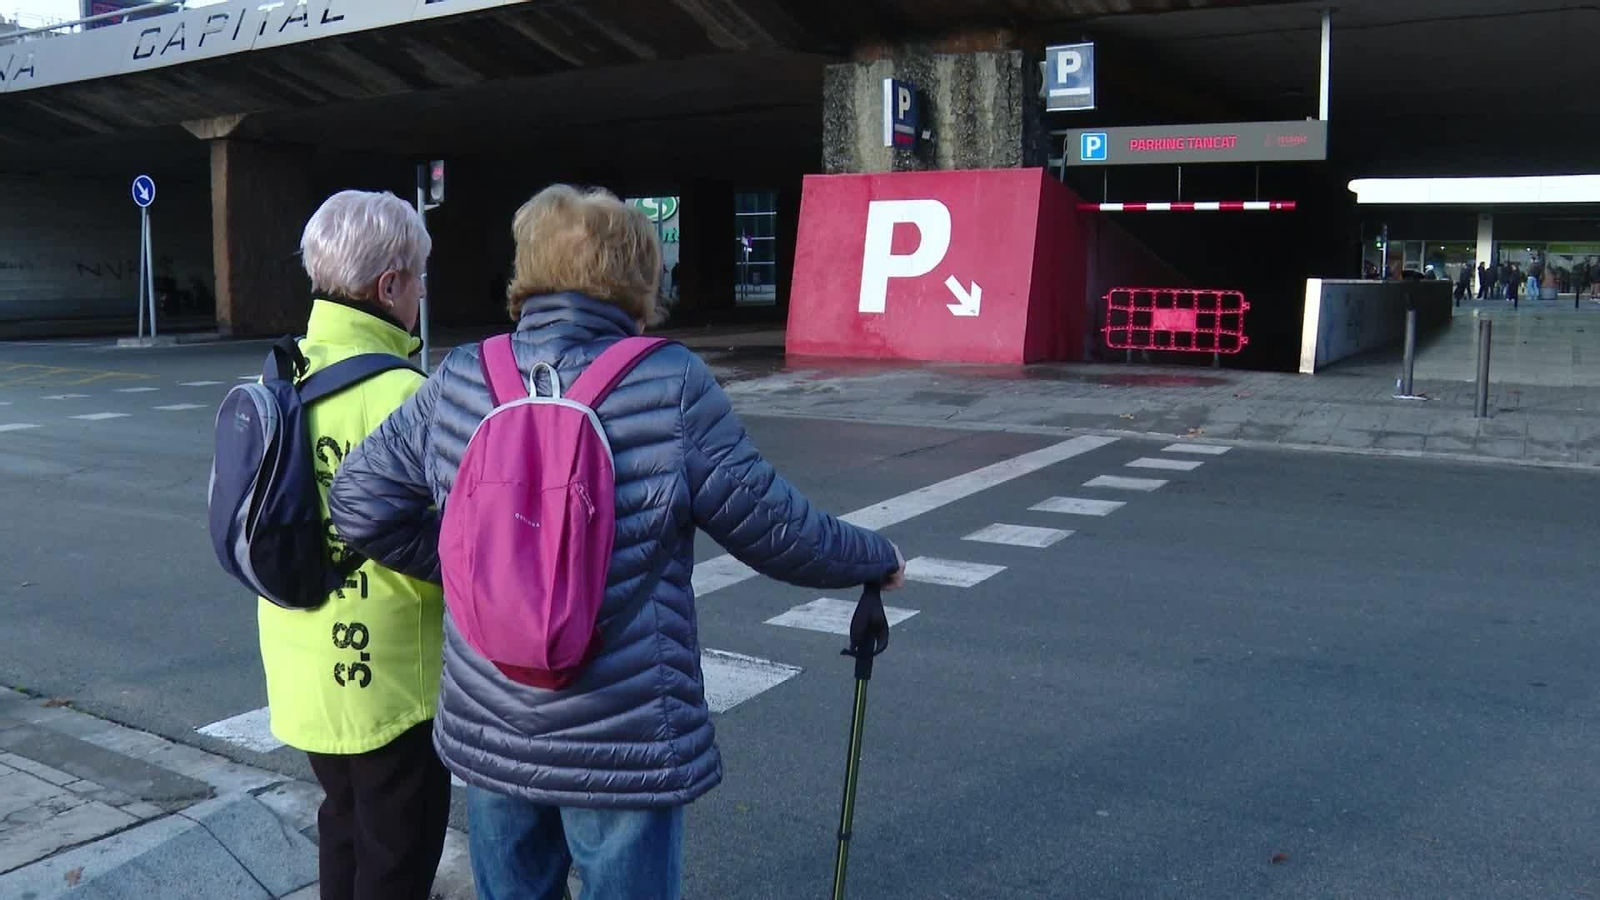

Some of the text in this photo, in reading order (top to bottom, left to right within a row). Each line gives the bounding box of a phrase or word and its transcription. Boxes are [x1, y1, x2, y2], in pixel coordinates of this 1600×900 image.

[132, 0, 345, 60] CAPITAL
[1057, 50, 1082, 84] P
[898, 86, 911, 120] P
[1086, 136, 1101, 158] P
[1129, 134, 1238, 151] PARKING TANCAT
[858, 199, 952, 313] P
[332, 621, 372, 689] 3.8
